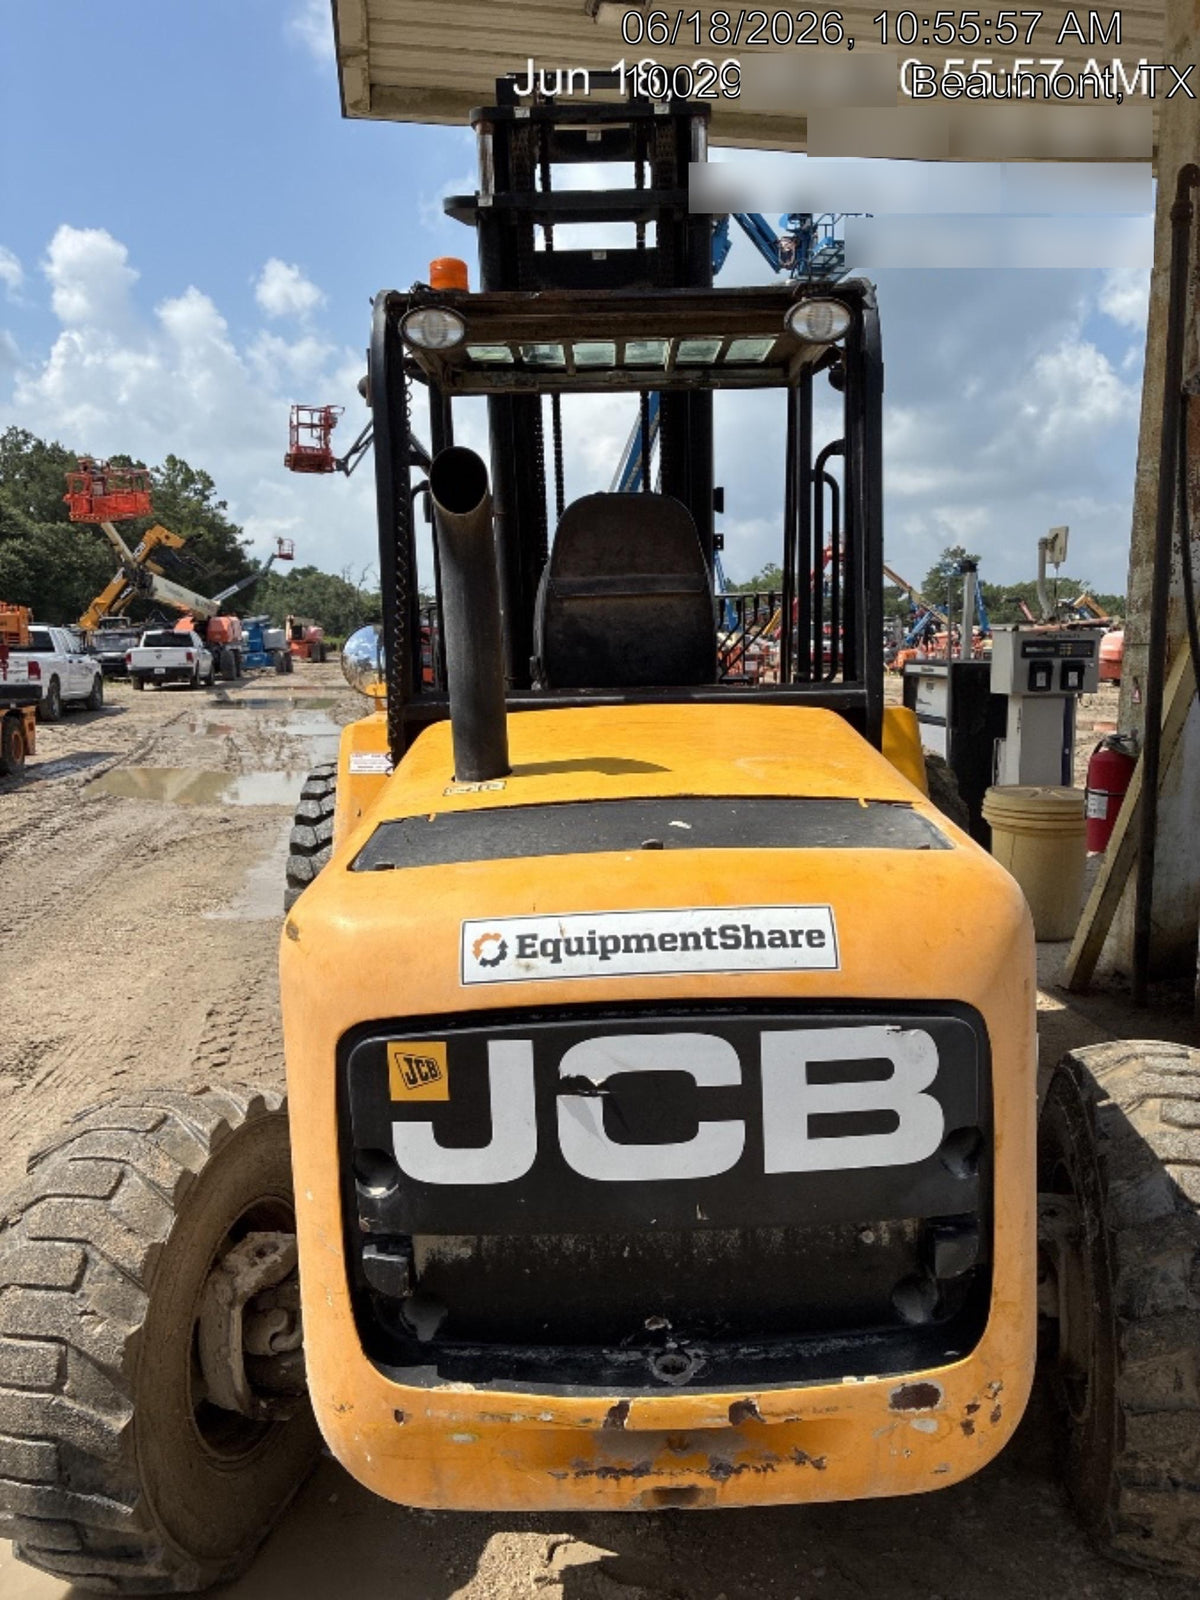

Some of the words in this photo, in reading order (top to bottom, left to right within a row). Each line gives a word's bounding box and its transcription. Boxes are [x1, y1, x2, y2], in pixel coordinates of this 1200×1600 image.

[515, 922, 826, 964] EquipmentShare
[402, 1056, 440, 1085] JCB
[391, 1025, 945, 1185] JCB
